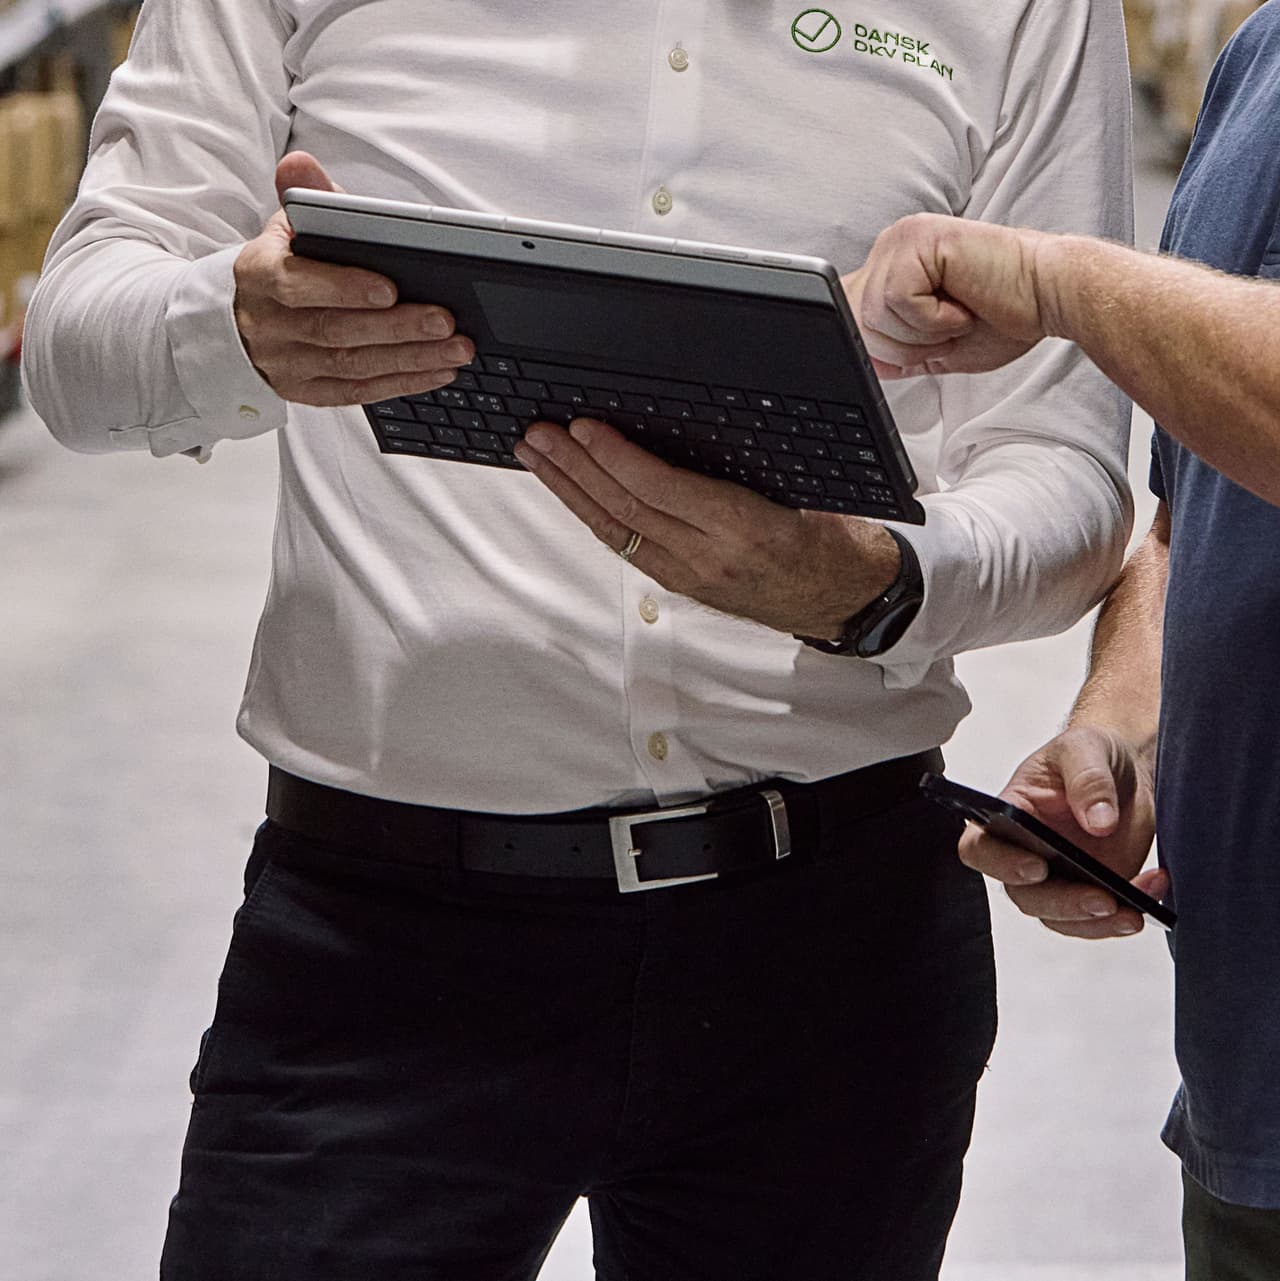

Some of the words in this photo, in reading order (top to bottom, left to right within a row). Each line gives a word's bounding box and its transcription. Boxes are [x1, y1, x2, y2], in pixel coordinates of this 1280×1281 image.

[854, 23, 929, 55] DANSK
[854, 39, 896, 58] DKV
[903, 52, 954, 81] PLAN
